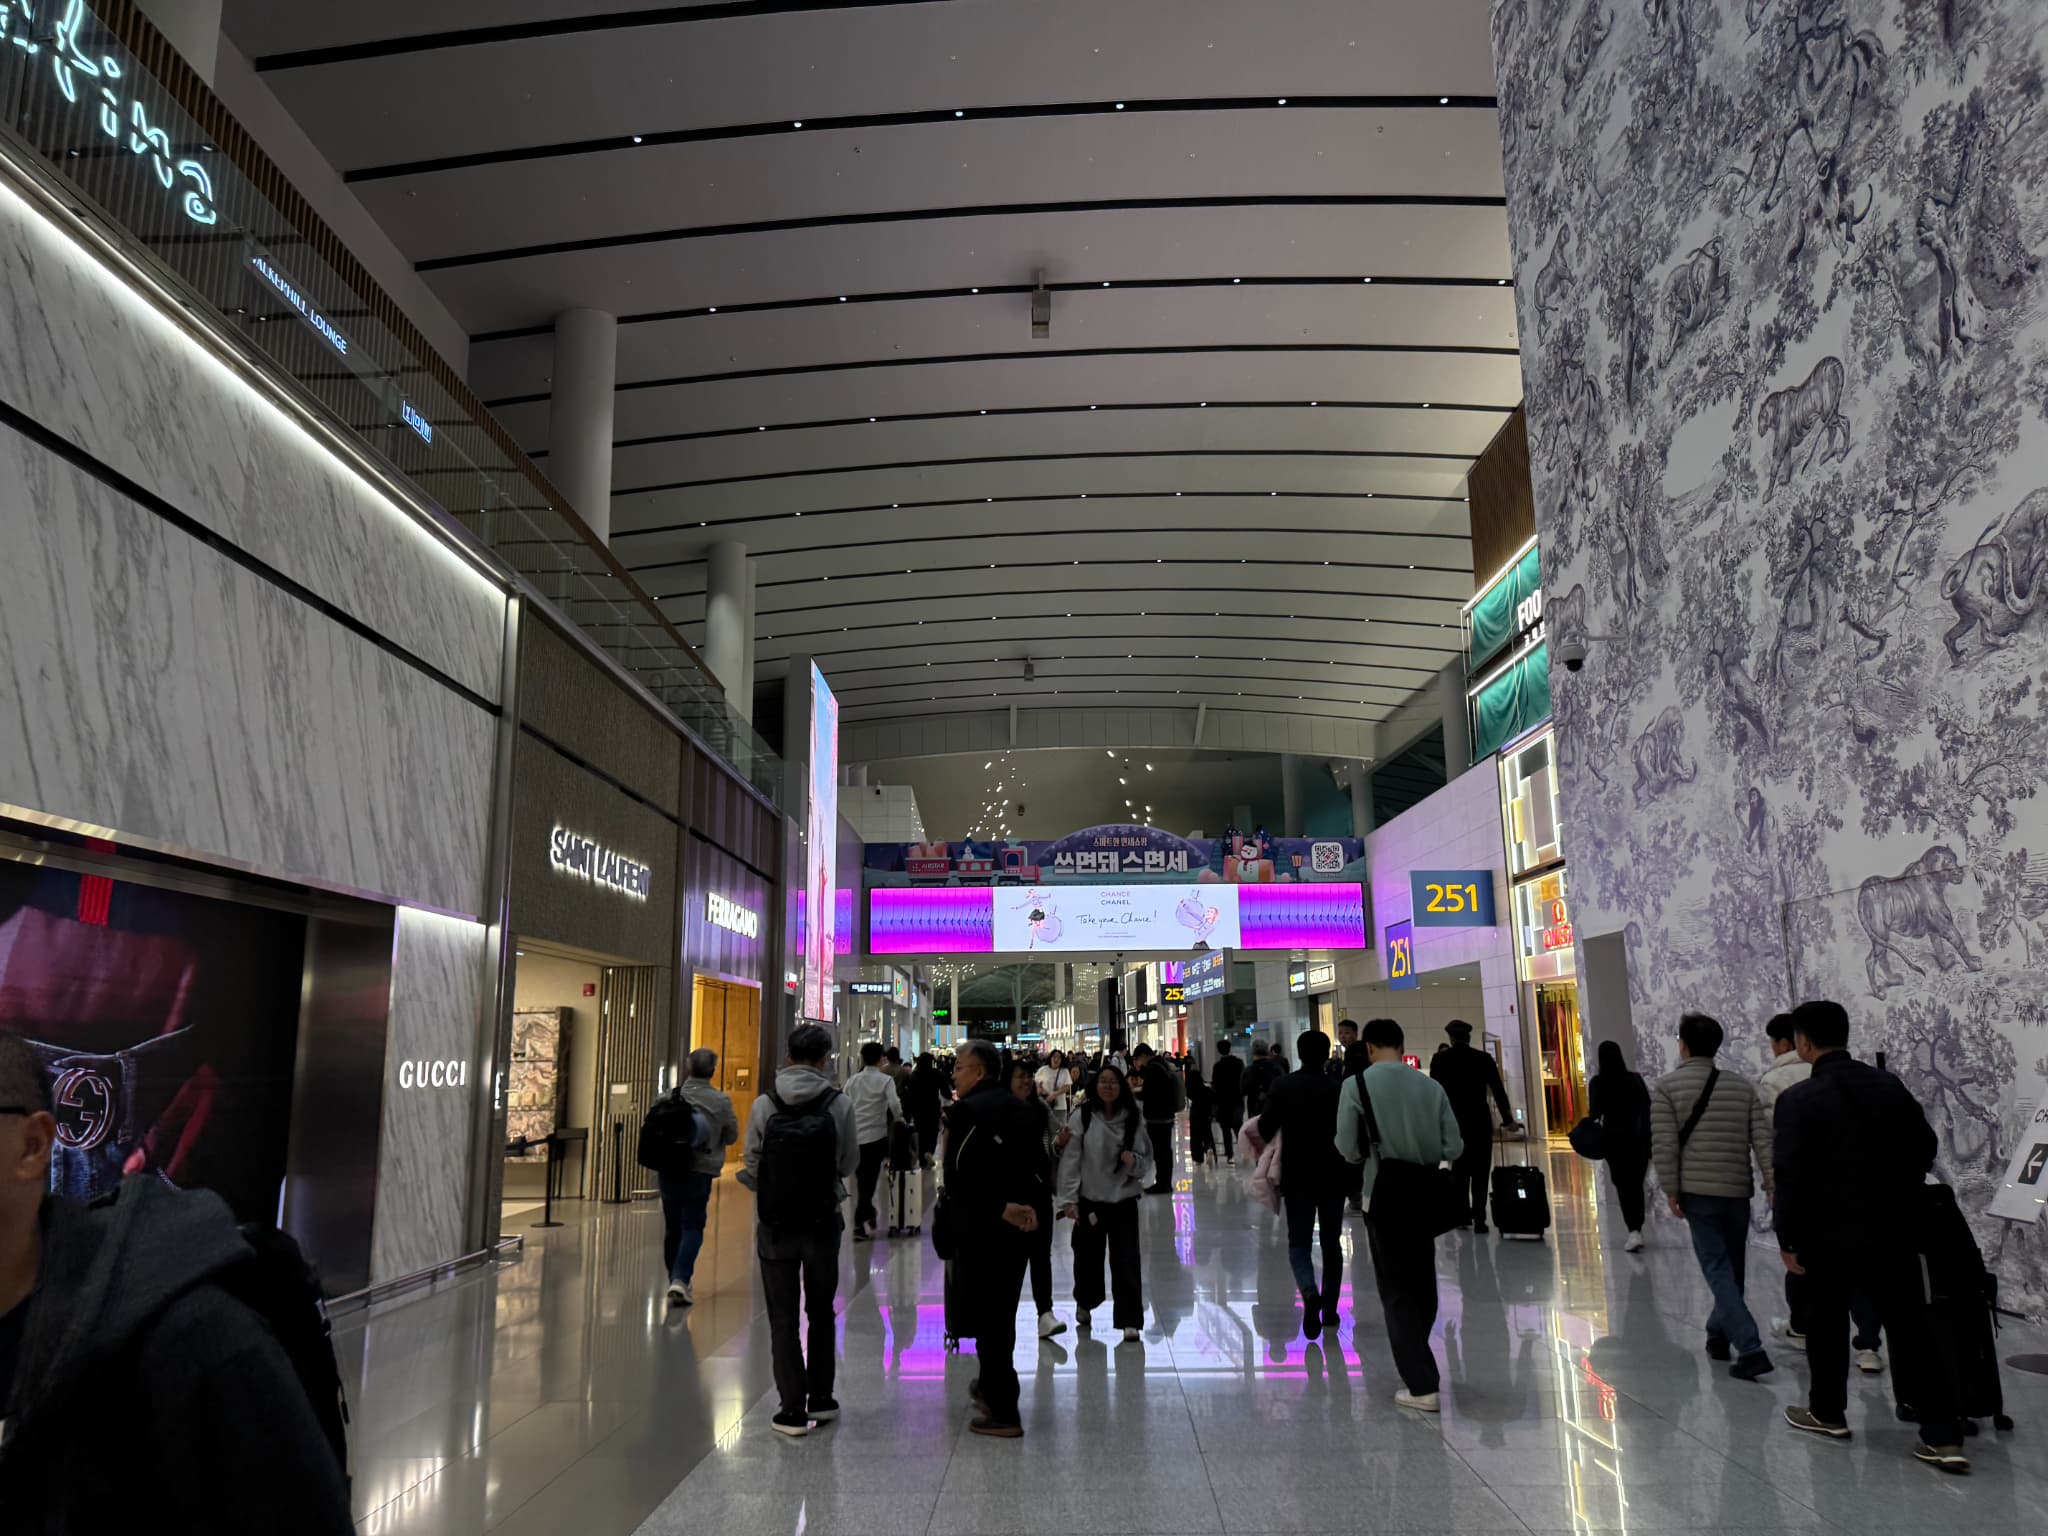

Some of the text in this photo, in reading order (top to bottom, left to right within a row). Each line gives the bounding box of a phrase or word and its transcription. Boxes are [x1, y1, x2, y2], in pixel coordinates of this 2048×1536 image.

[309, 308, 348, 355] LOUNGE
[551, 827, 652, 900] SAINT LAURENT
[1054, 850, 1188, 873] 쓰면돼 스면세
[707, 892, 758, 940] FERRAGAMO
[1425, 884, 1478, 912] 251
[1390, 936, 1411, 978] 251
[399, 1060, 466, 1089] GUCCI
